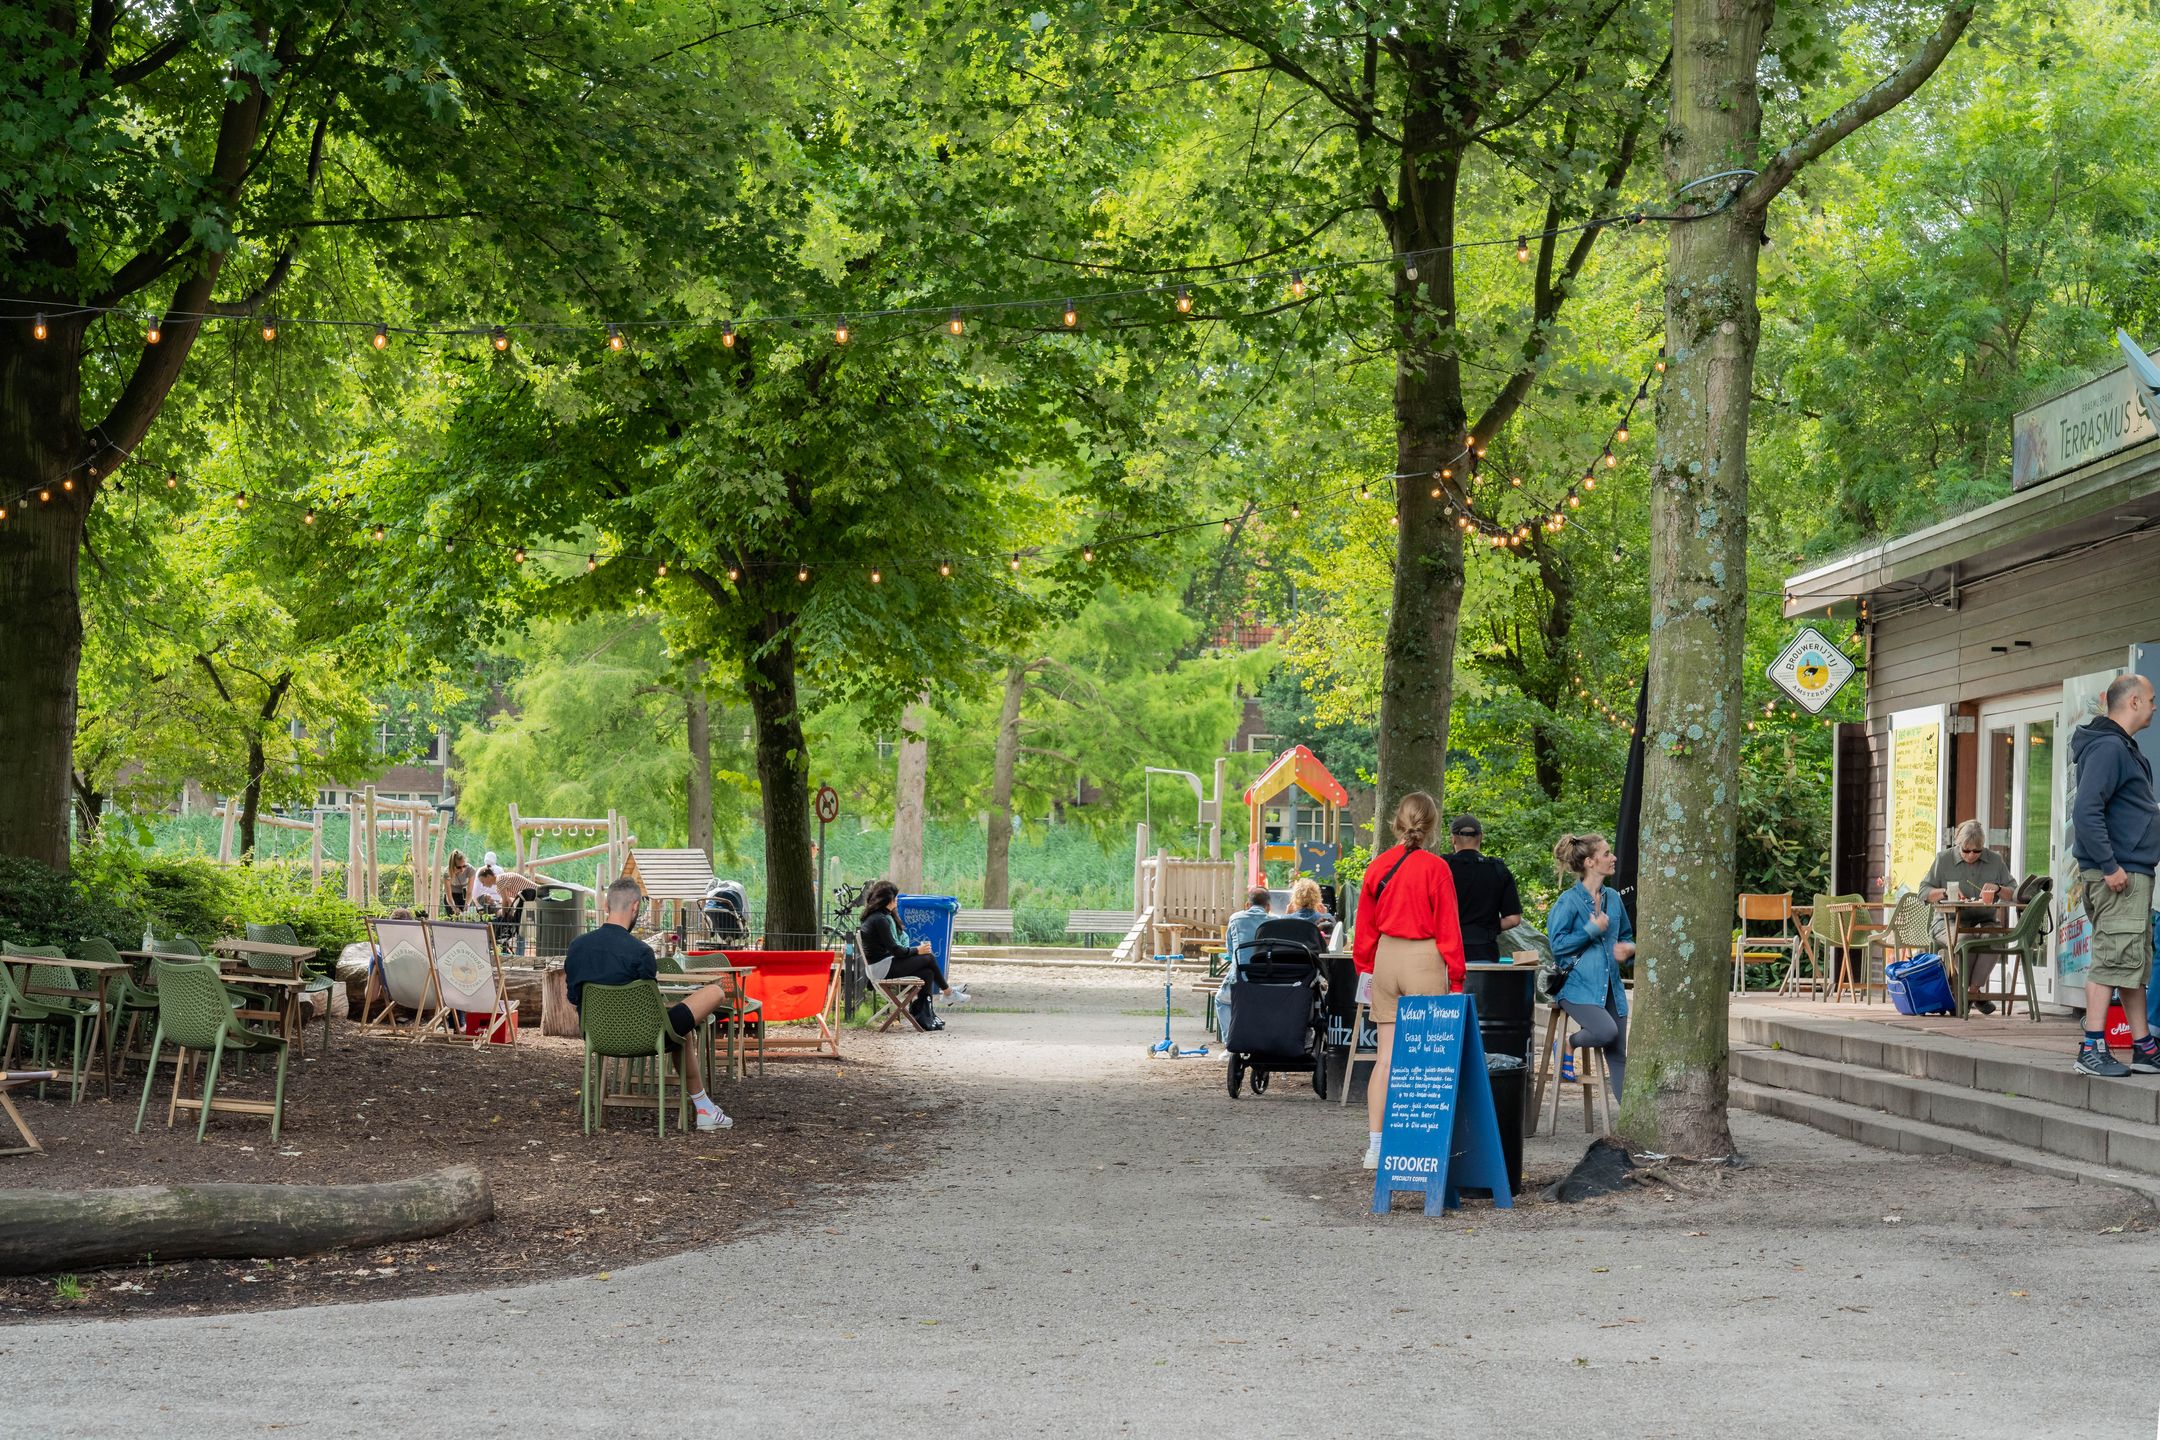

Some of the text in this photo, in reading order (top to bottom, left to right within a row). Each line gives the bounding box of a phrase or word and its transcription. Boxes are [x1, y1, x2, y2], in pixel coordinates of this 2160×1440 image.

[2060, 400, 2131, 460] TERRASMUS
[1792, 682, 1835, 698] AMSTERDAM
[1384, 1155, 1439, 1172] STOOKER
